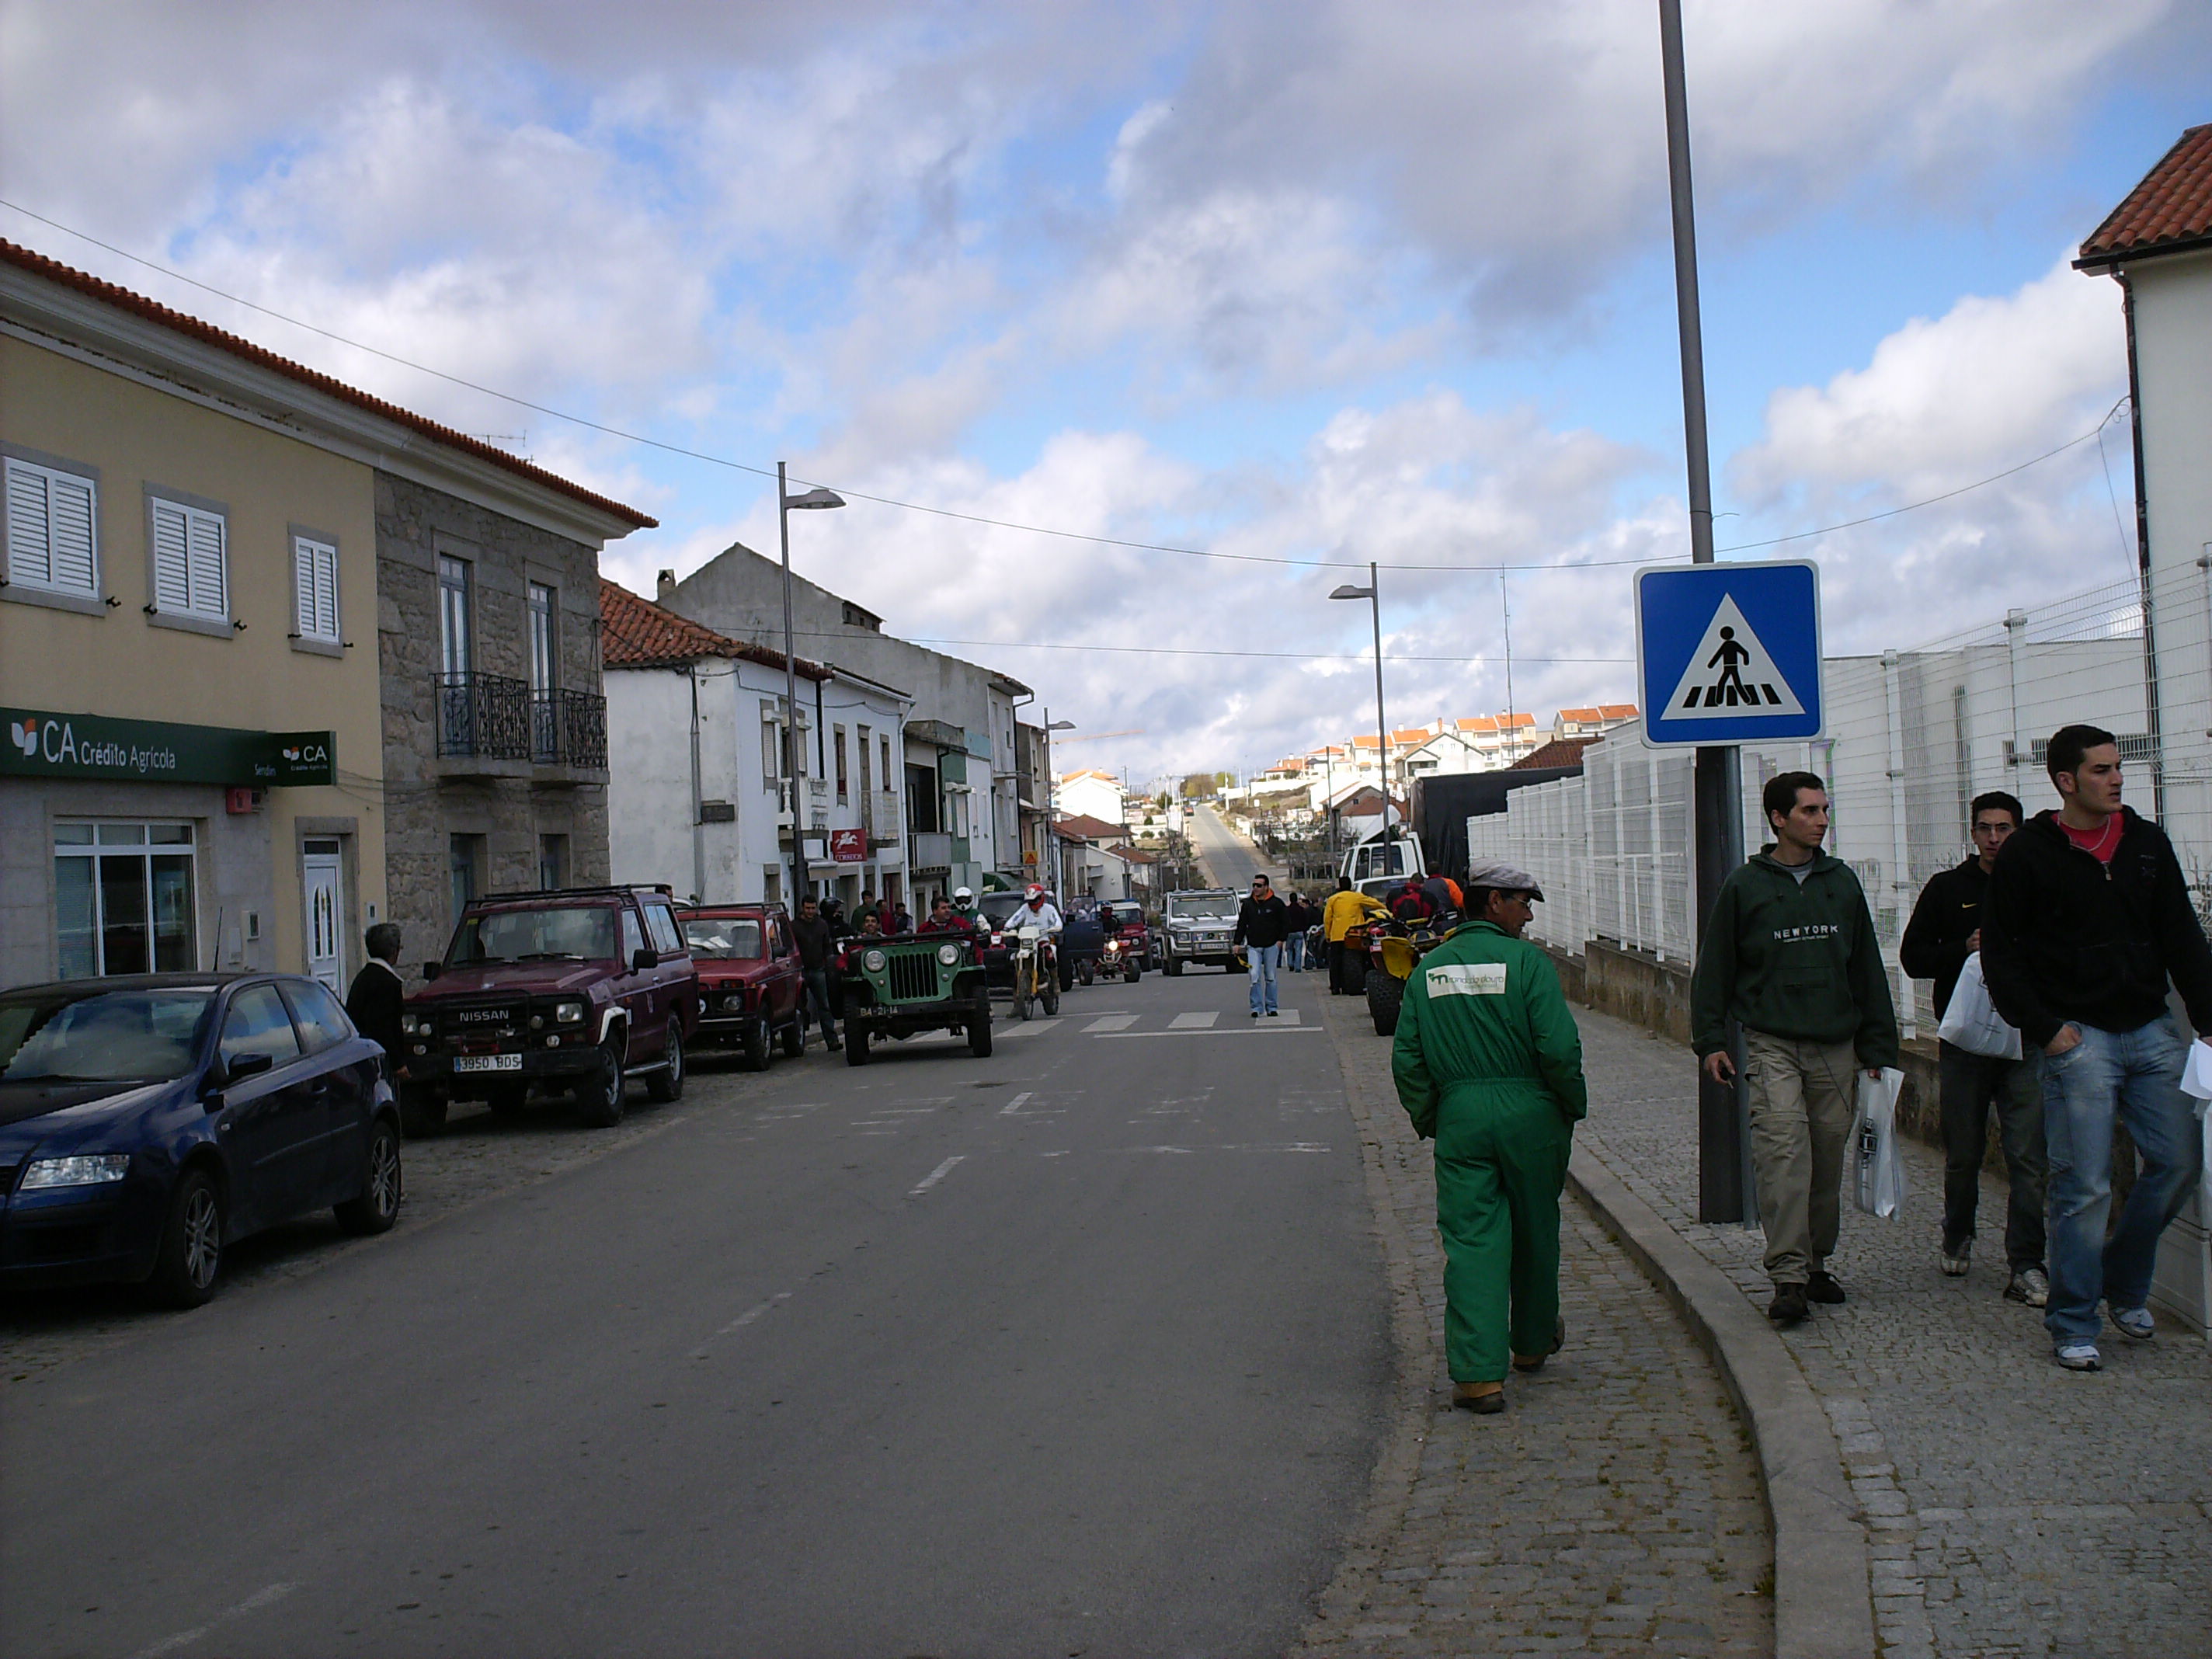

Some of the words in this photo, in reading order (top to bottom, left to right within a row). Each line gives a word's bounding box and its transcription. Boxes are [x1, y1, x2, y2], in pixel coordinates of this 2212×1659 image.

[43, 719, 78, 764] CA
[81, 741, 127, 767] Crédito
[130, 744, 176, 774] Agrícola
[303, 745, 328, 763] CA
[1774, 928, 1800, 939] NEW
[1803, 925, 1838, 934] YORK
[460, 1010, 509, 1021] NISSAN
[461, 1056, 489, 1069] 3950
[497, 1056, 520, 1068] BDS
